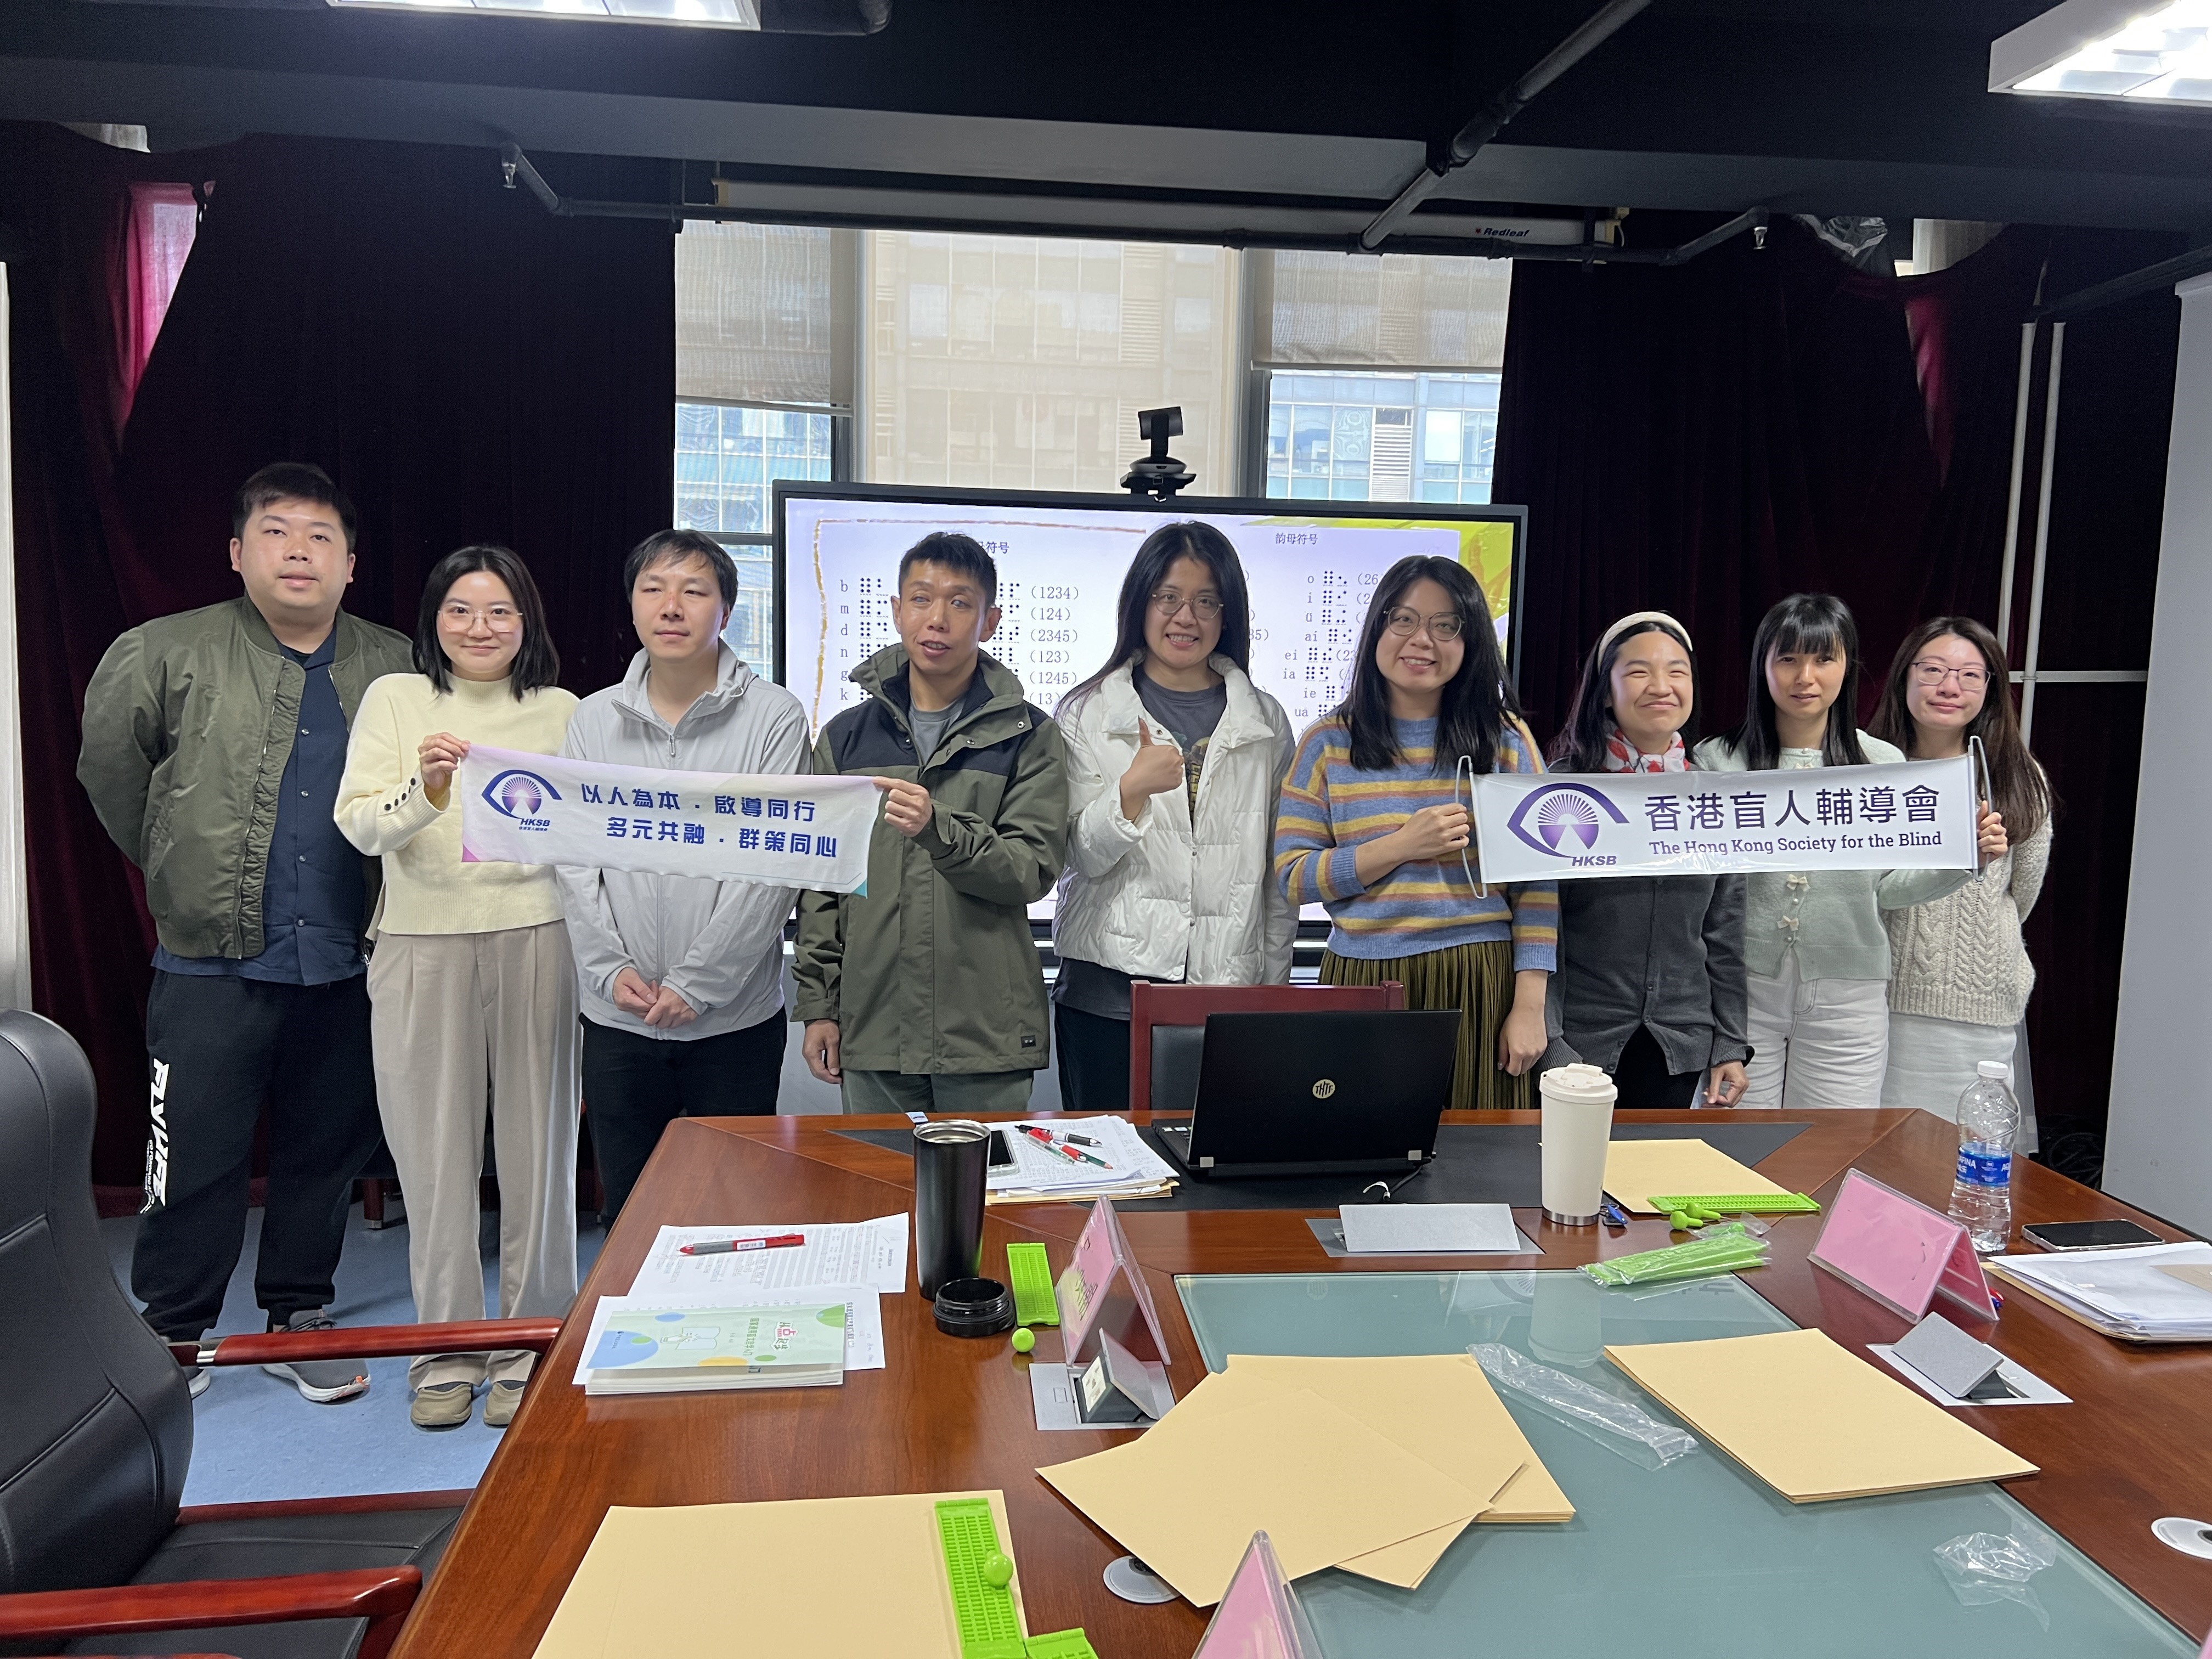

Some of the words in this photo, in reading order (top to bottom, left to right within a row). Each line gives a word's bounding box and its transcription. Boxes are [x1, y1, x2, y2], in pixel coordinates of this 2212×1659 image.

[1483, 228, 1530, 237] Redleaf
[1275, 532, 1318, 545] 韵母符号
[978, 541, 1010, 554] 符号
[1307, 575, 1314, 584] o
[1358, 573, 1379, 585] (26
[840, 579, 848, 592] b
[1031, 585, 1079, 600] (1234)
[1307, 592, 1313, 603] i
[840, 605, 849, 614] m
[1031, 607, 1071, 621] (124)
[840, 623, 848, 636] d
[1030, 629, 1078, 643] (2345)
[1305, 630, 1318, 642] ai
[840, 648, 848, 658] n
[1030, 650, 1070, 664] (123)
[1285, 649, 1298, 661] ei
[840, 670, 849, 681] g
[1030, 670, 1077, 685] (1245)
[1283, 668, 1296, 679] ia
[840, 687, 848, 701] k
[1303, 687, 1317, 698] ie
[1294, 708, 1309, 717] ua
[1644, 783, 1940, 832] 香港盲人輔導會
[520, 818, 551, 827] HKSB
[1649, 841, 1680, 855] The
[1684, 839, 1728, 855] Hong
[1732, 838, 1774, 854] Kong
[1778, 835, 1836, 851] Society
[1841, 834, 1864, 849] for
[1867, 833, 1895, 848] the
[1898, 831, 1942, 847] Blind
[1571, 855, 1617, 867] HKSB
